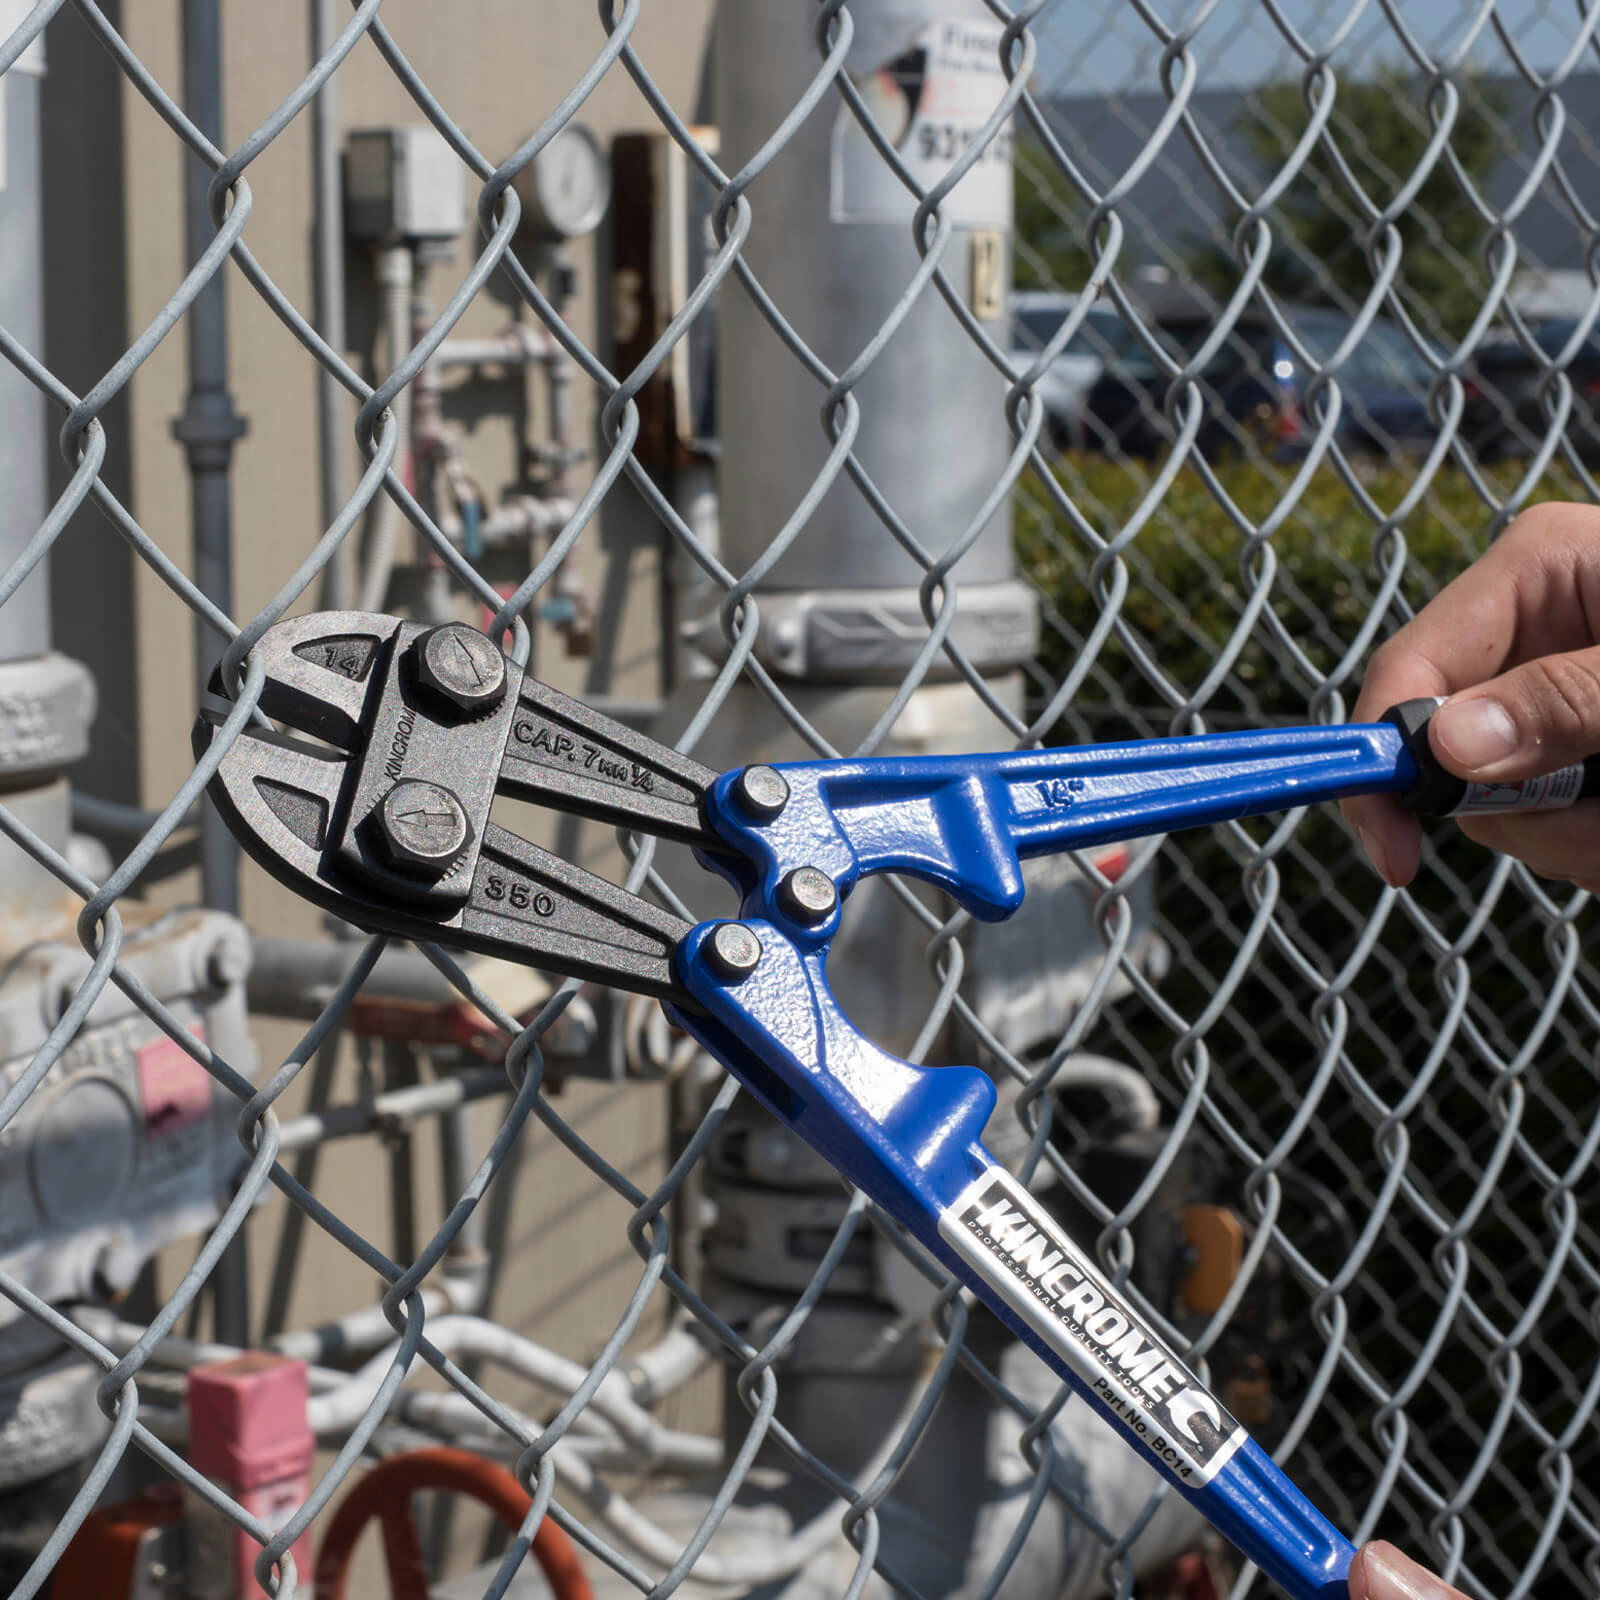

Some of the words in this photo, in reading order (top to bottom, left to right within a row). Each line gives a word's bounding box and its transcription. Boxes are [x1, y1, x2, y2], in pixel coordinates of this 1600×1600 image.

[324, 646, 361, 680] 14
[513, 719, 576, 763] CAP.
[484, 875, 556, 917] 350
[966, 1220, 1057, 1312] PROFESSIONAL
[1061, 1315, 1114, 1368] QUALITY
[1116, 1370, 1156, 1410] TOOLS
[973, 1197, 1188, 1403] KINCROME
[1093, 1377, 1126, 1415] Part
[1124, 1410, 1149, 1439] No.
[1150, 1435, 1195, 1480] BC14
